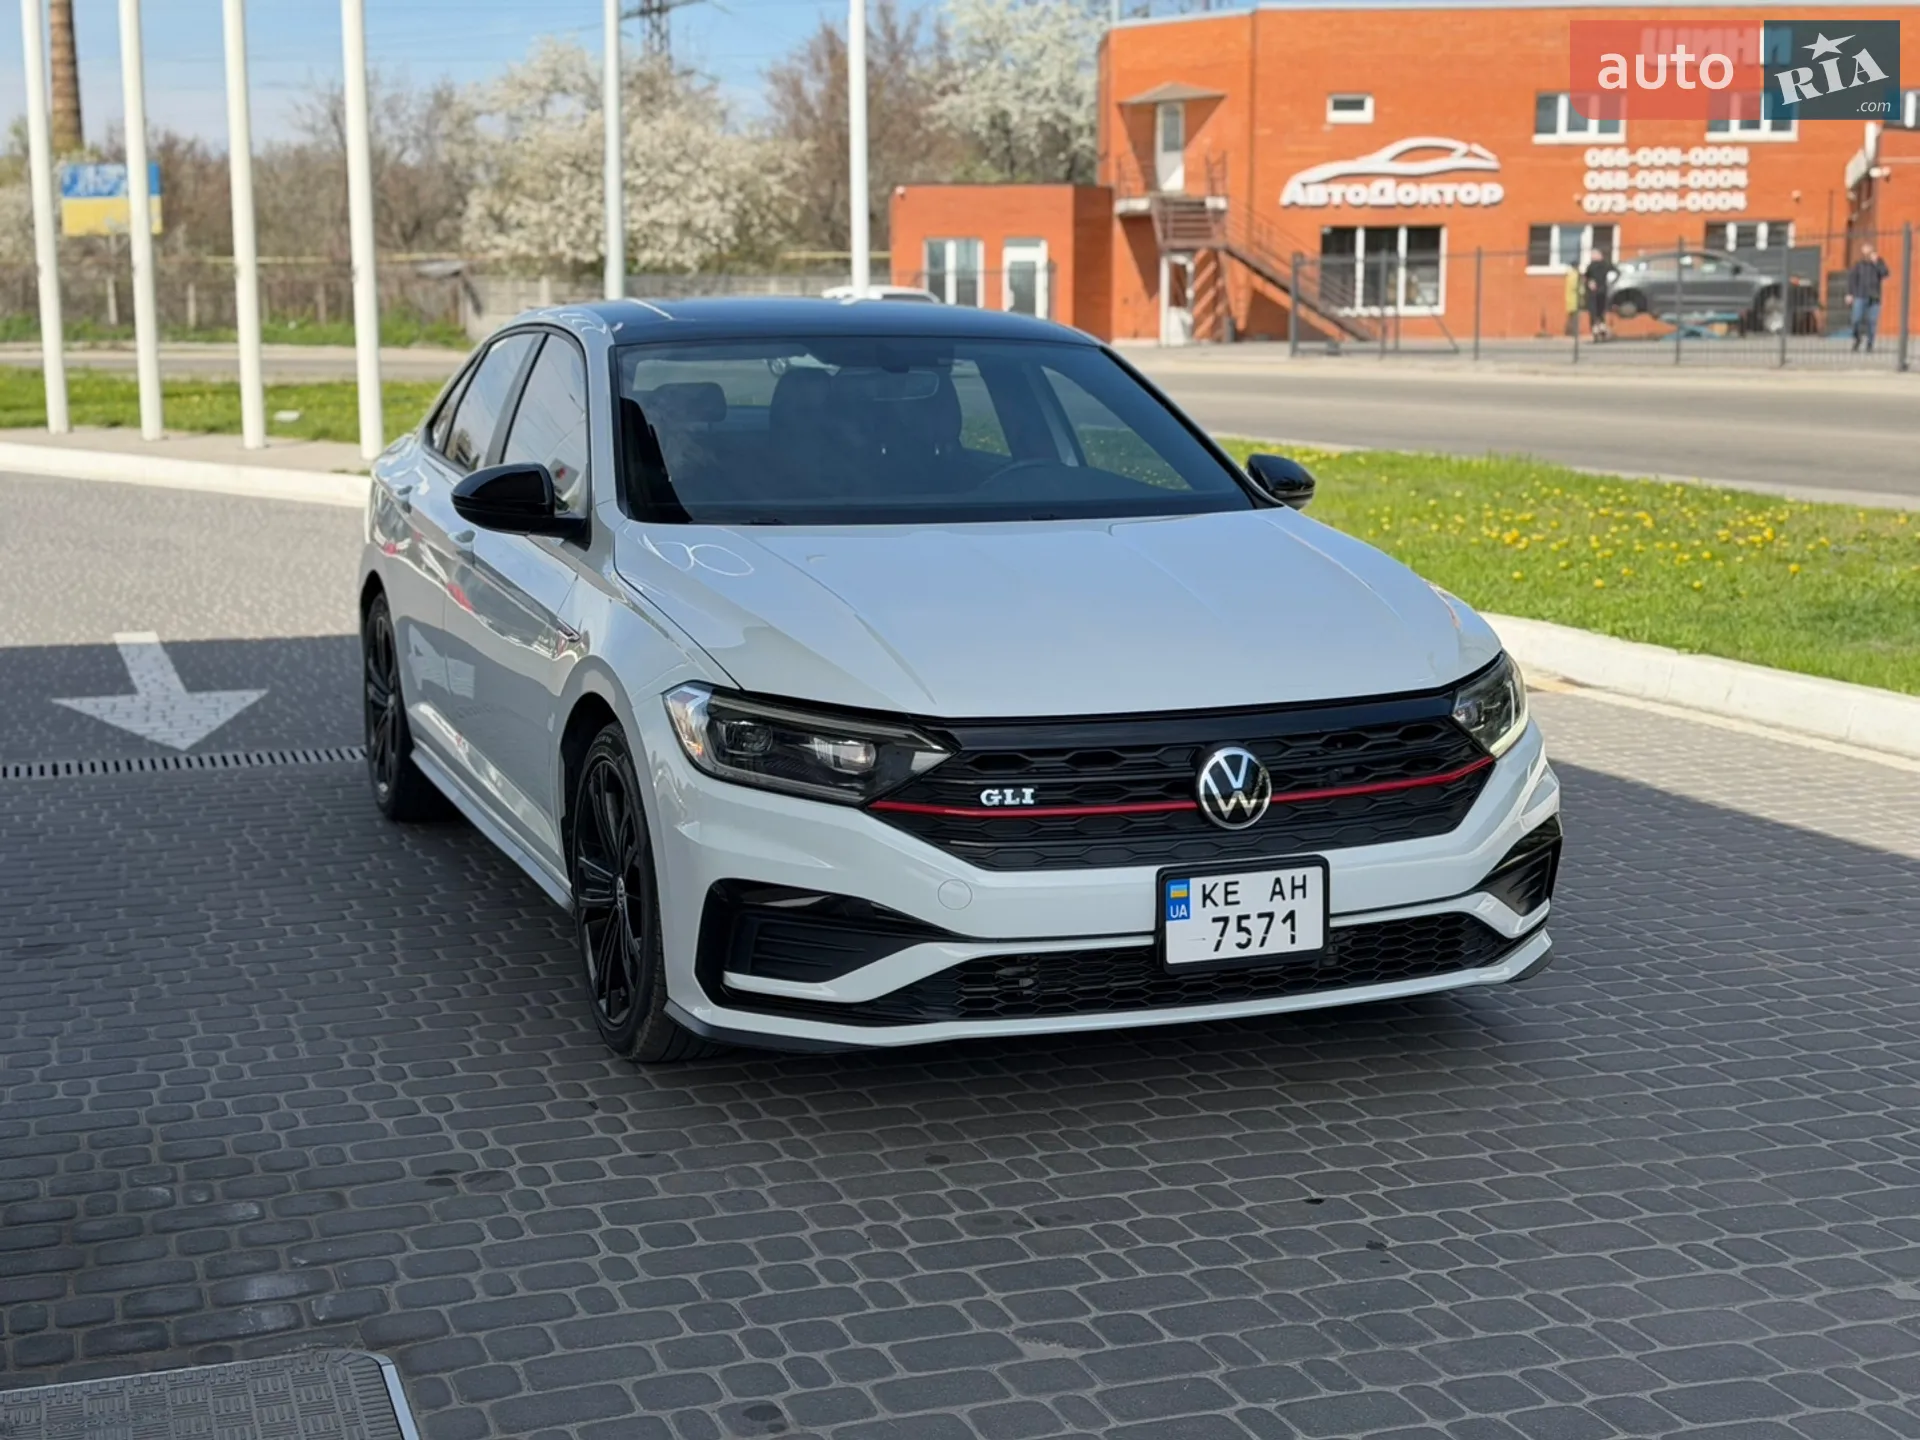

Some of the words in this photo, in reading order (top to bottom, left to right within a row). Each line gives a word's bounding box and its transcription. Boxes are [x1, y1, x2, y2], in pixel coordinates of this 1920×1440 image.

[980, 787, 1035, 806] GLI
[1201, 880, 1241, 908] KE
[1269, 874, 1307, 902] AH
[1169, 904, 1188, 919] UA
[1211, 909, 1297, 952] 7571
